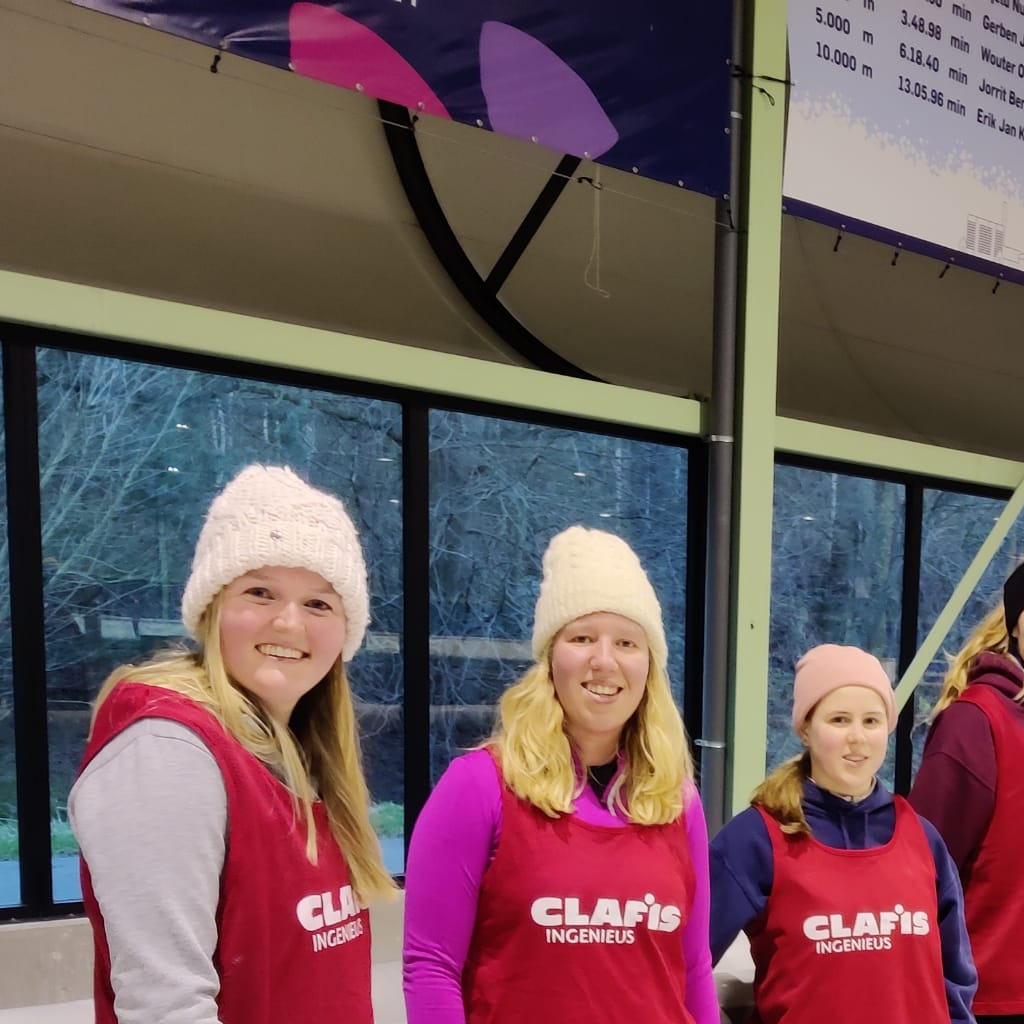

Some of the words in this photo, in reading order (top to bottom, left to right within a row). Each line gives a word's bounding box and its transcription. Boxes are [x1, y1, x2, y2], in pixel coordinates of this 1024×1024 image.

[901, 10, 942, 40] 3.48.98
[951, 35, 970, 53] min
[981, 45, 1016, 74] Wouter
[952, 4, 972, 22] min
[983, 15, 1017, 43] Gerben
[815, 7, 850, 35] 5.000
[863, 31, 874, 45] m
[900, 43, 940, 72] 6.18.40
[949, 67, 968, 85] min
[979, 79, 1007, 102] Jorrit
[816, 41, 857, 71] 10.000
[862, 63, 873, 78] m
[898, 75, 944, 107] 13.05.96
[947, 98, 966, 116] min
[977, 108, 996, 129] Erik
[998, 119, 1017, 137] Jan
[546, 928, 635, 944] INGENIEUS
[816, 936, 892, 954] INGENIEUS
